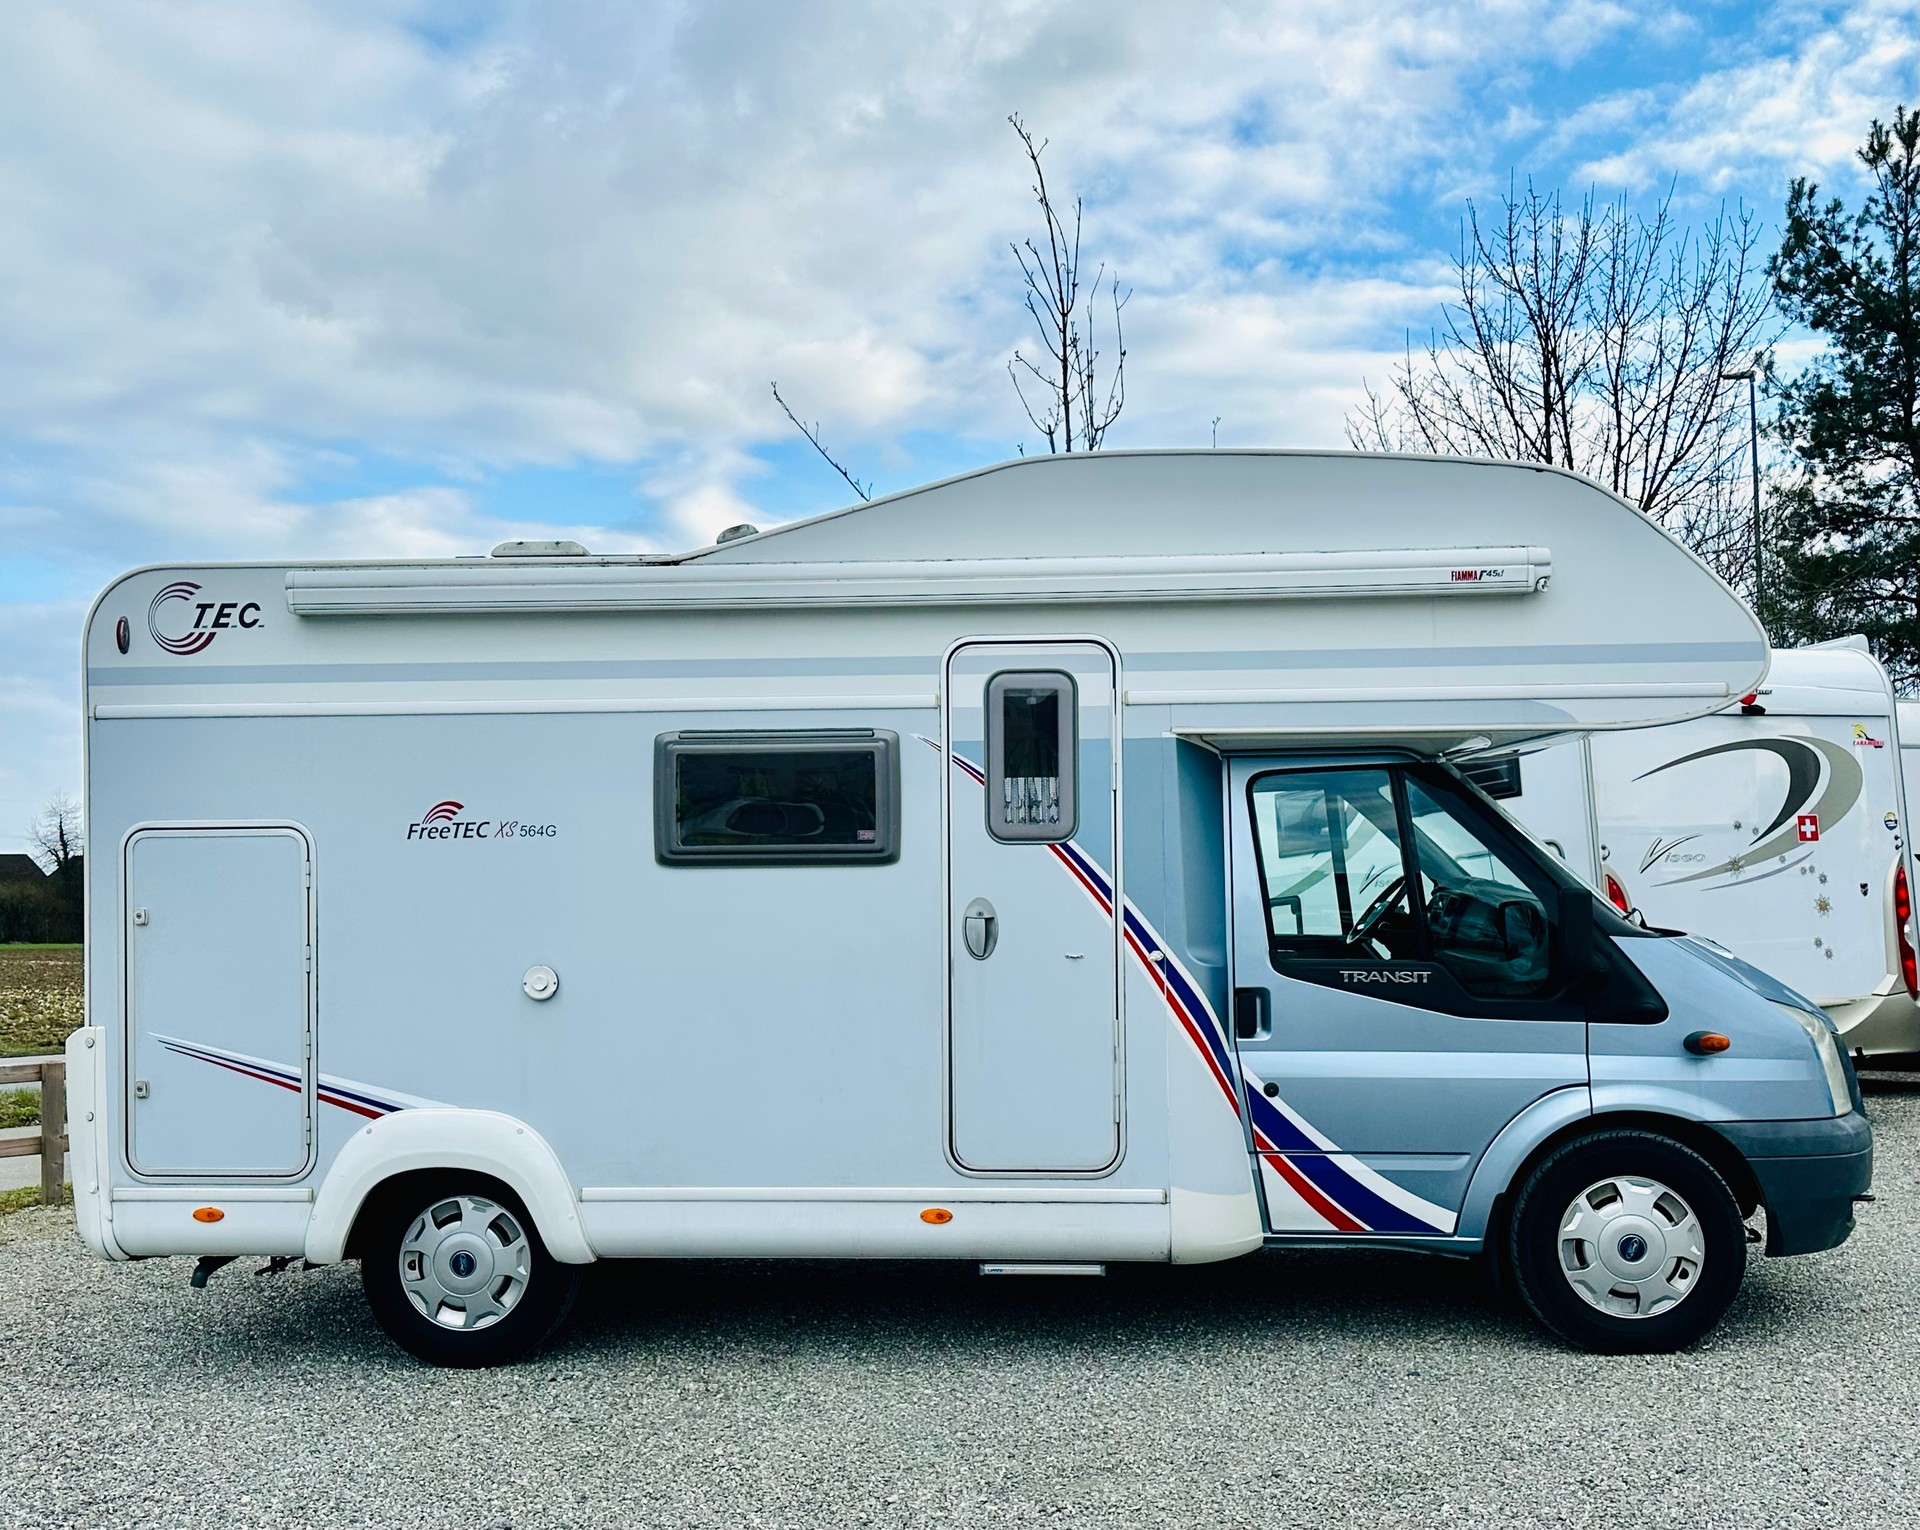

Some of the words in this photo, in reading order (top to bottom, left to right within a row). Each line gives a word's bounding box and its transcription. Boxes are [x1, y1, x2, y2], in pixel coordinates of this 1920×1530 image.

[1451, 570, 1478, 581] FIAMMA
[407, 821, 490, 840] FreeTEC
[494, 820, 518, 838] XS
[519, 824, 557, 838] 564G
[1339, 970, 1432, 984] TRANSIT
